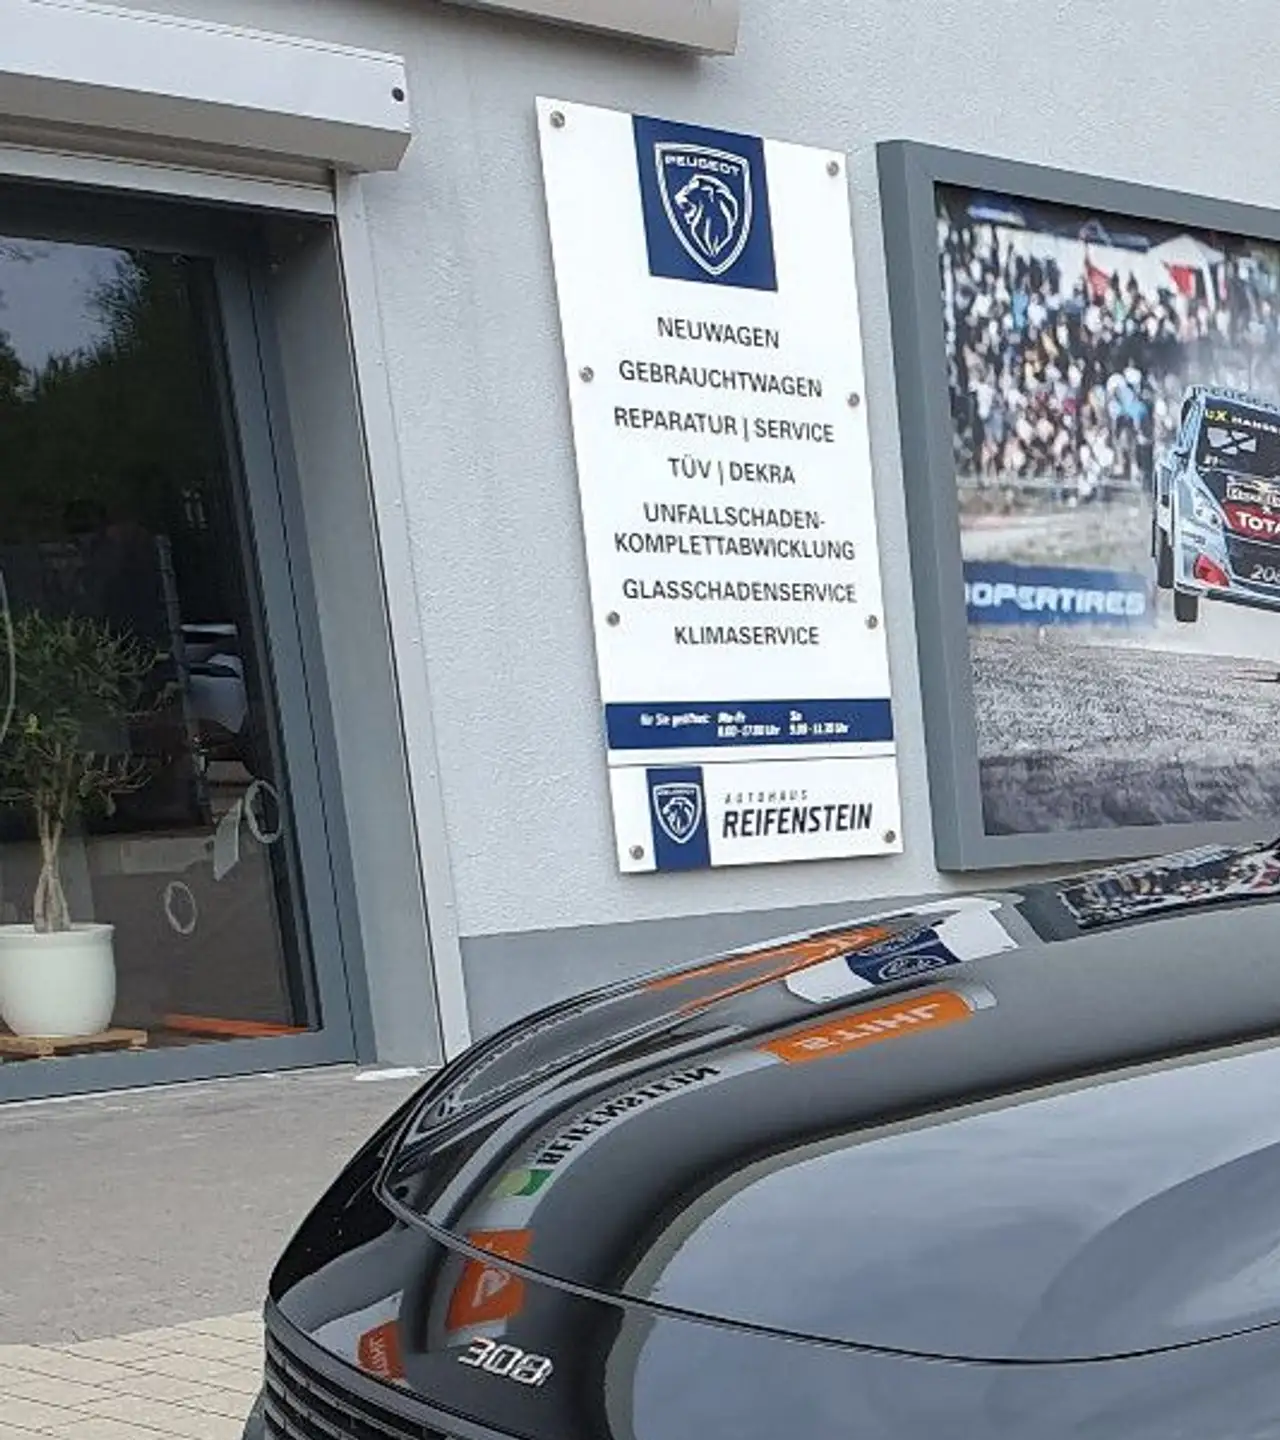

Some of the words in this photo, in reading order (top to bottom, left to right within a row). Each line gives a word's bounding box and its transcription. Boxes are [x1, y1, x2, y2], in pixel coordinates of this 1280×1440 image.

[664, 155, 740, 177] PEUGEOT
[656, 316, 780, 349] NEUWAGEN
[618, 360, 823, 398] GEBRAUCHTWAGEN
[613, 407, 738, 436] REPARATUR
[755, 419, 835, 443] SERVICE
[667, 454, 711, 480] TÜV
[729, 461, 796, 485] DEKRA
[643, 502, 826, 529] UNFALLSCHADEN-
[614, 532, 856, 561] KOMPLETTABWICKLUNG
[622, 579, 858, 603] GLASSCHADENSERVICE
[674, 626, 820, 646] KLIMASERVICE
[722, 803, 873, 839] REIFENSTEIN
[457, 1336, 554, 1387] 308
